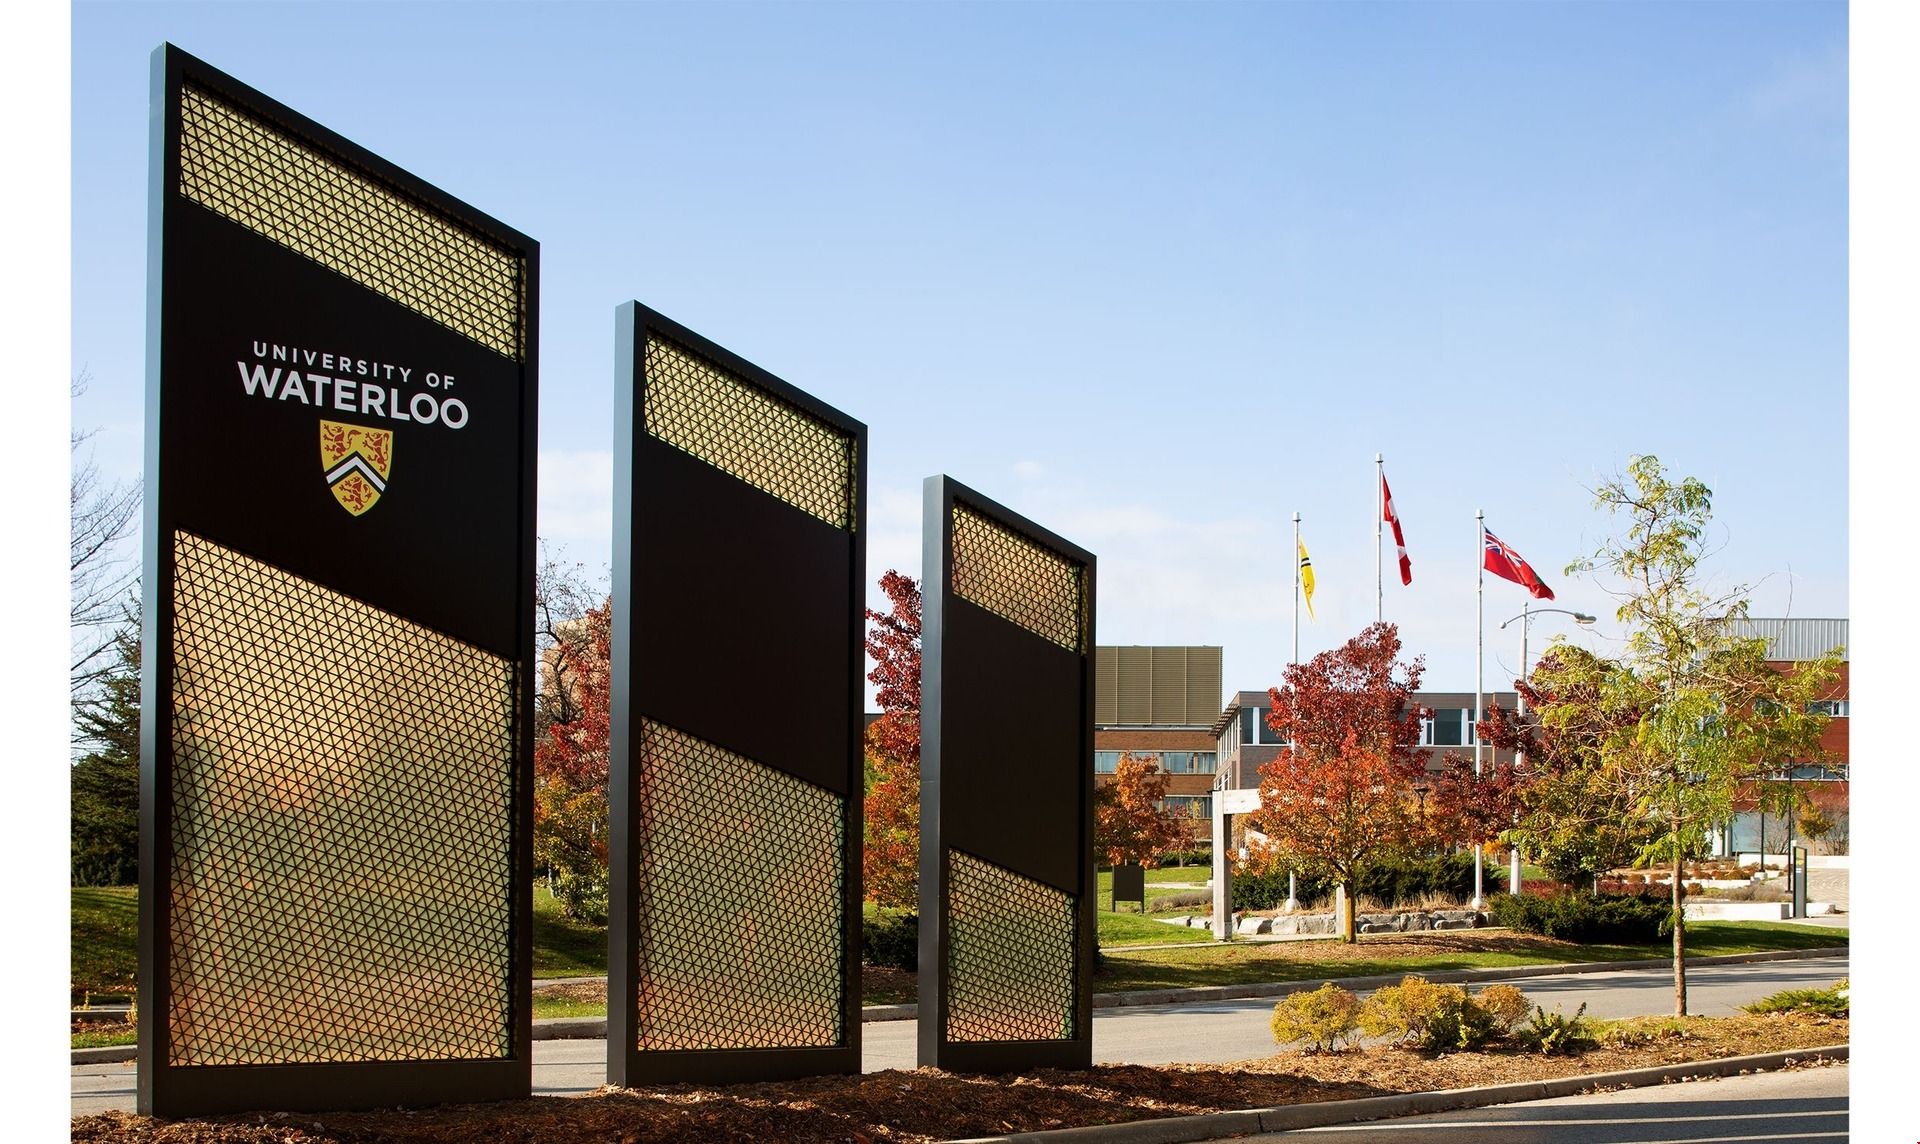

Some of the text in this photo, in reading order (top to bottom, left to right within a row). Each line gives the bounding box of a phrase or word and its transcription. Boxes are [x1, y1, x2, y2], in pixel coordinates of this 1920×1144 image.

[253, 340, 455, 390] UNIVERSITY OF
[237, 361, 469, 430] WATERLOO
